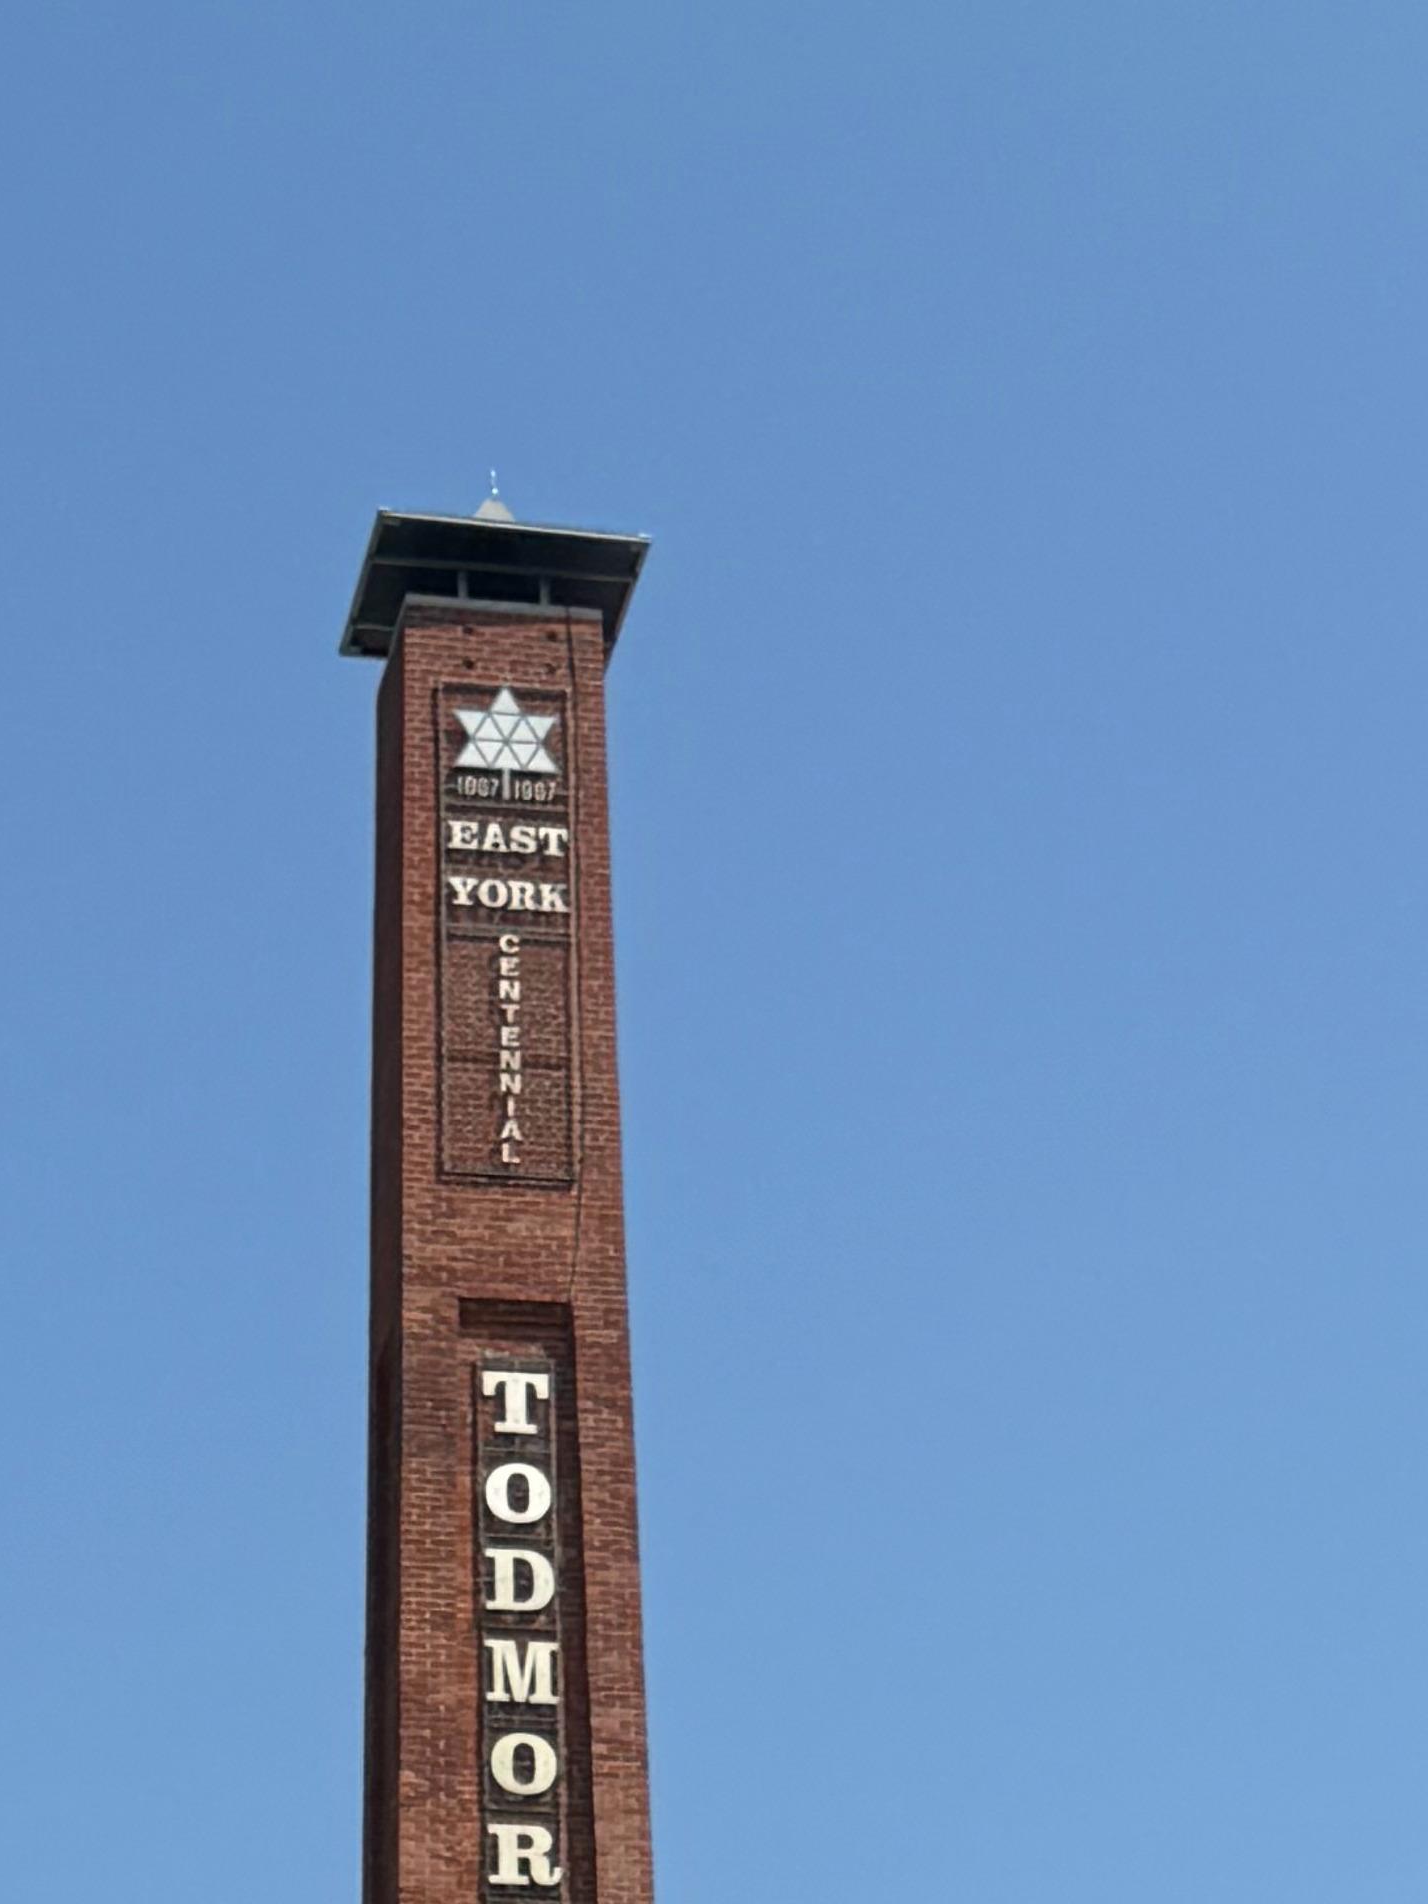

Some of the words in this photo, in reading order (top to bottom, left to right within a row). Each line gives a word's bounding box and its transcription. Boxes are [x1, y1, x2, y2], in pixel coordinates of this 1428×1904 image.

[448, 820, 569, 857] EAST
[448, 876, 570, 912] YORK
[499, 934, 522, 1163] CENTENNIAL
